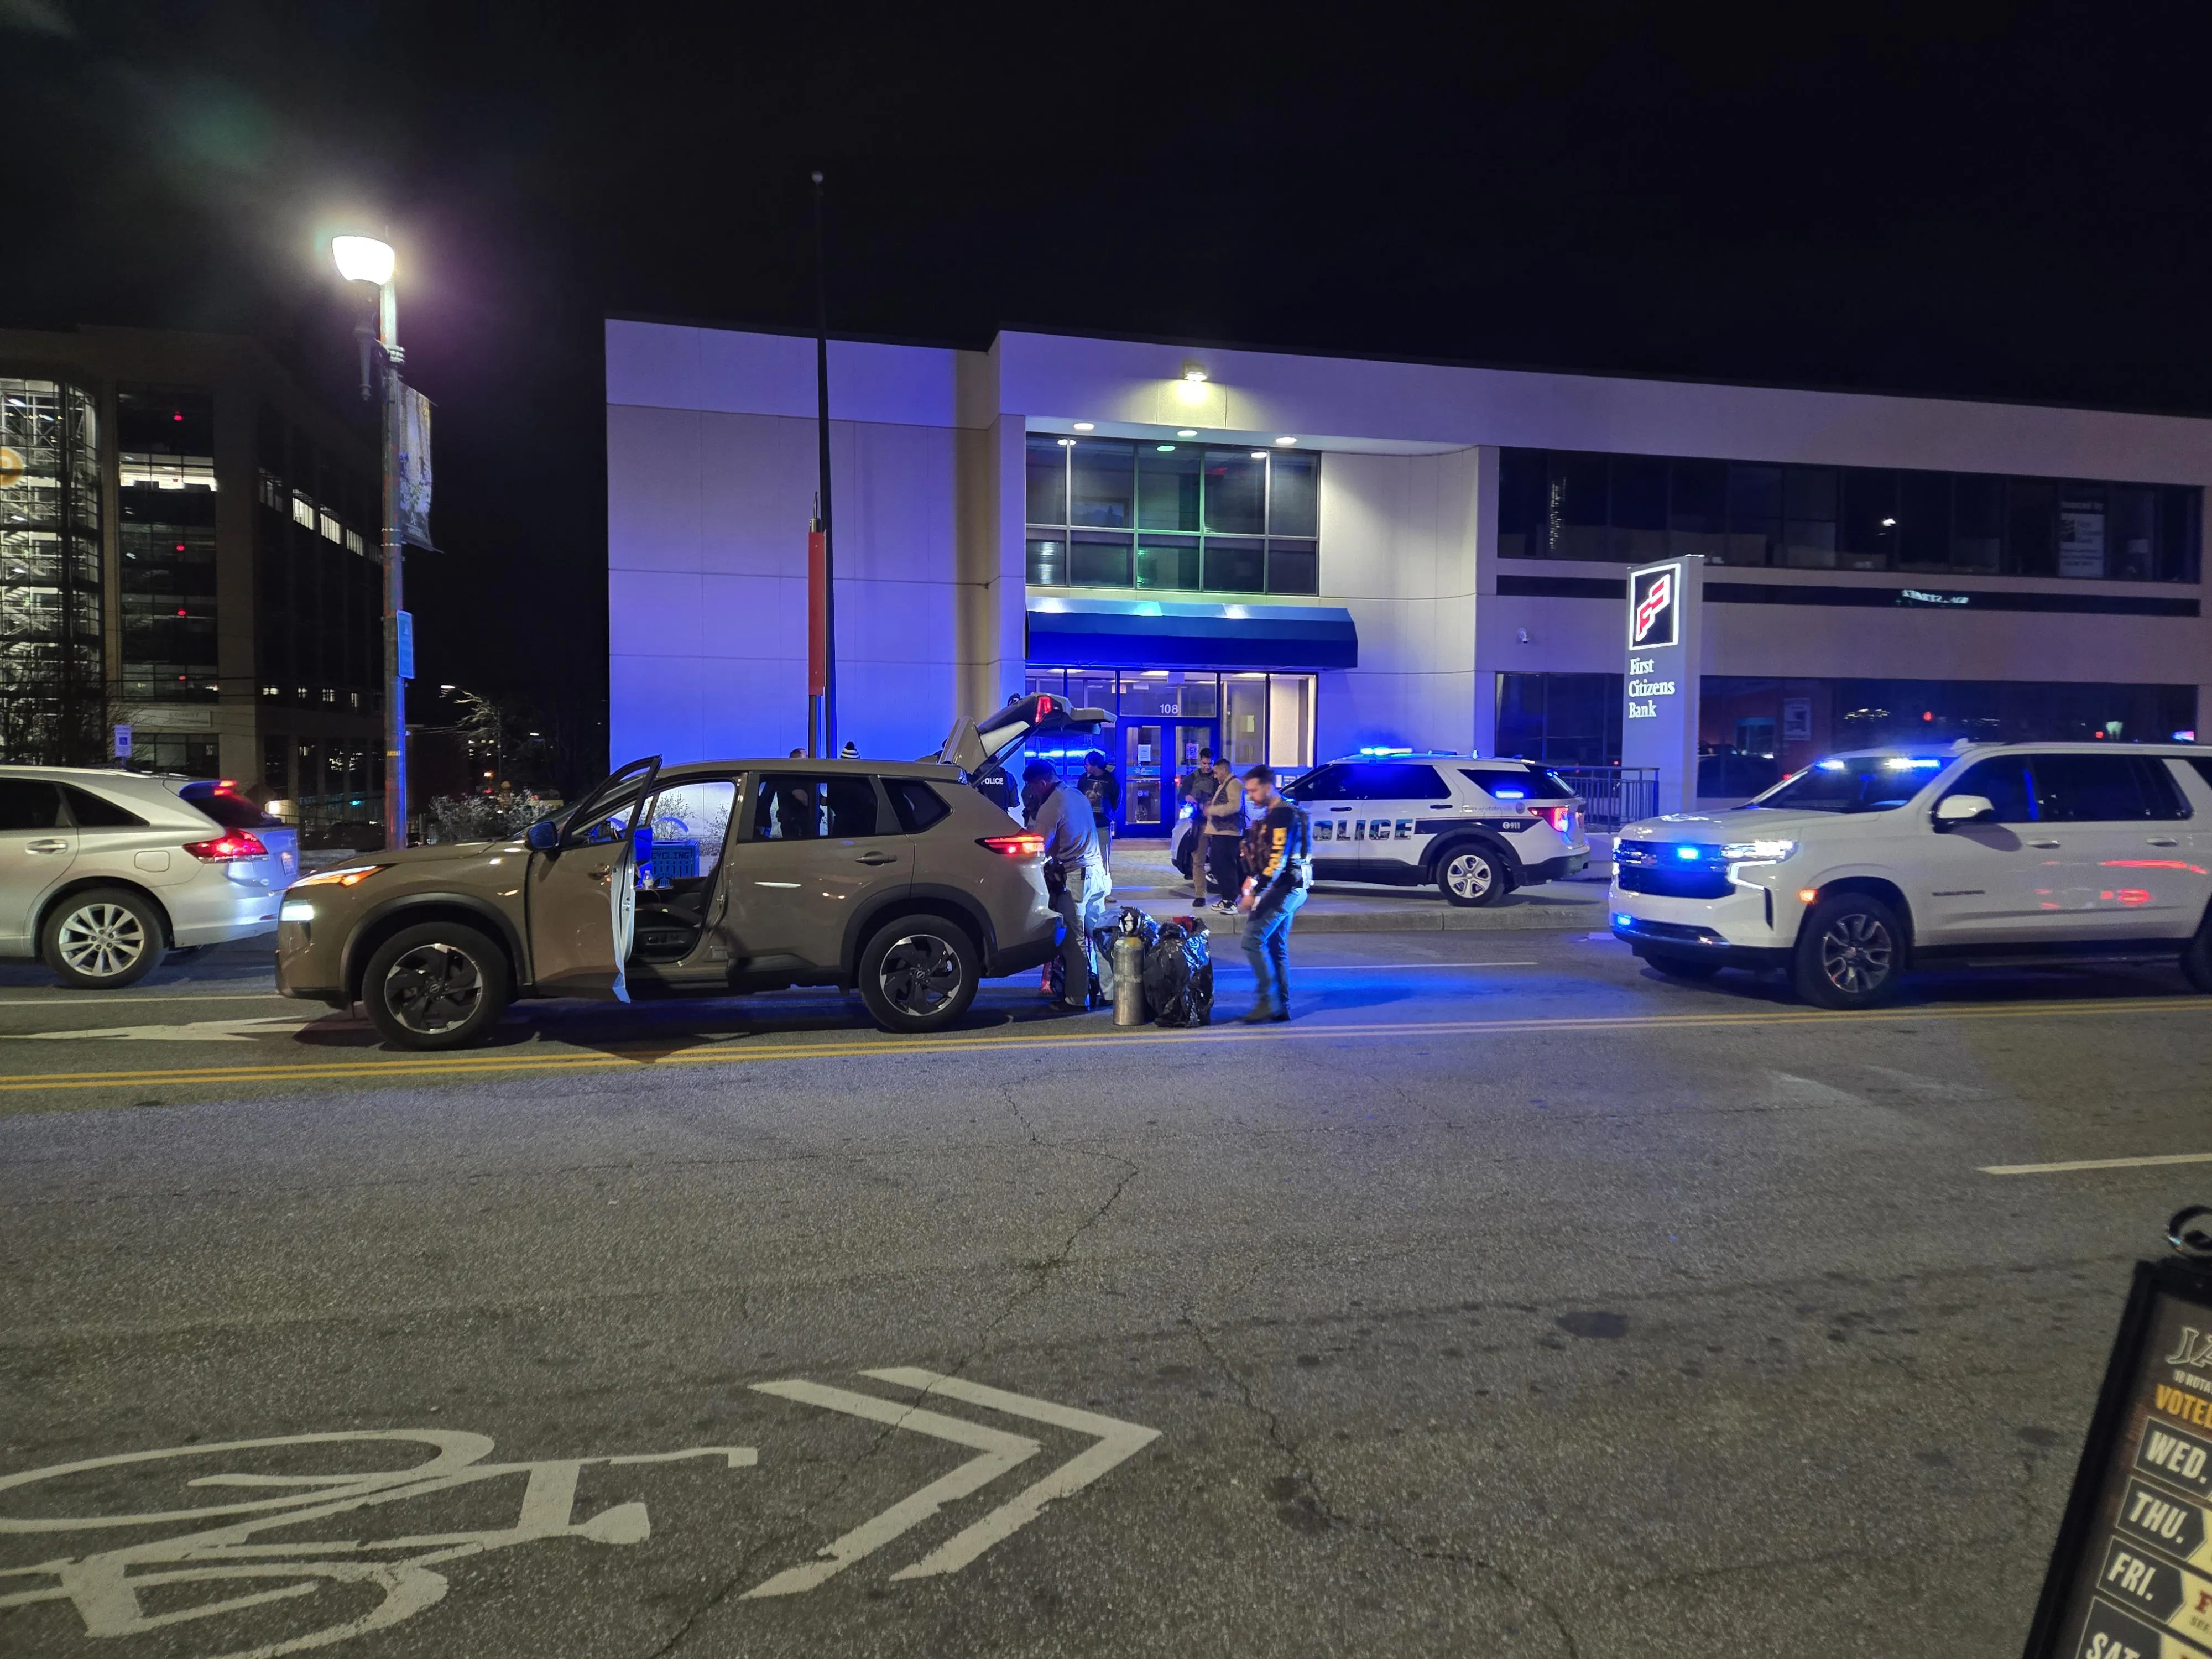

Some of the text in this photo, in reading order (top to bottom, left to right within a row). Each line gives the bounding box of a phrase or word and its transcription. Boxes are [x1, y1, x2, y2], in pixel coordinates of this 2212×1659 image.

[1629, 657, 1655, 675] First
[1628, 679, 1675, 697] Citizens
[1159, 703, 1178, 714] 108
[1628, 700, 1657, 718] Bank
[1312, 818, 1413, 841] OLICE
[1510, 821, 1520, 830] 911
[2146, 1431, 2207, 1484] WED.
[2130, 1491, 2187, 1545] THU.
[2107, 1552, 2156, 1601] FRI.
